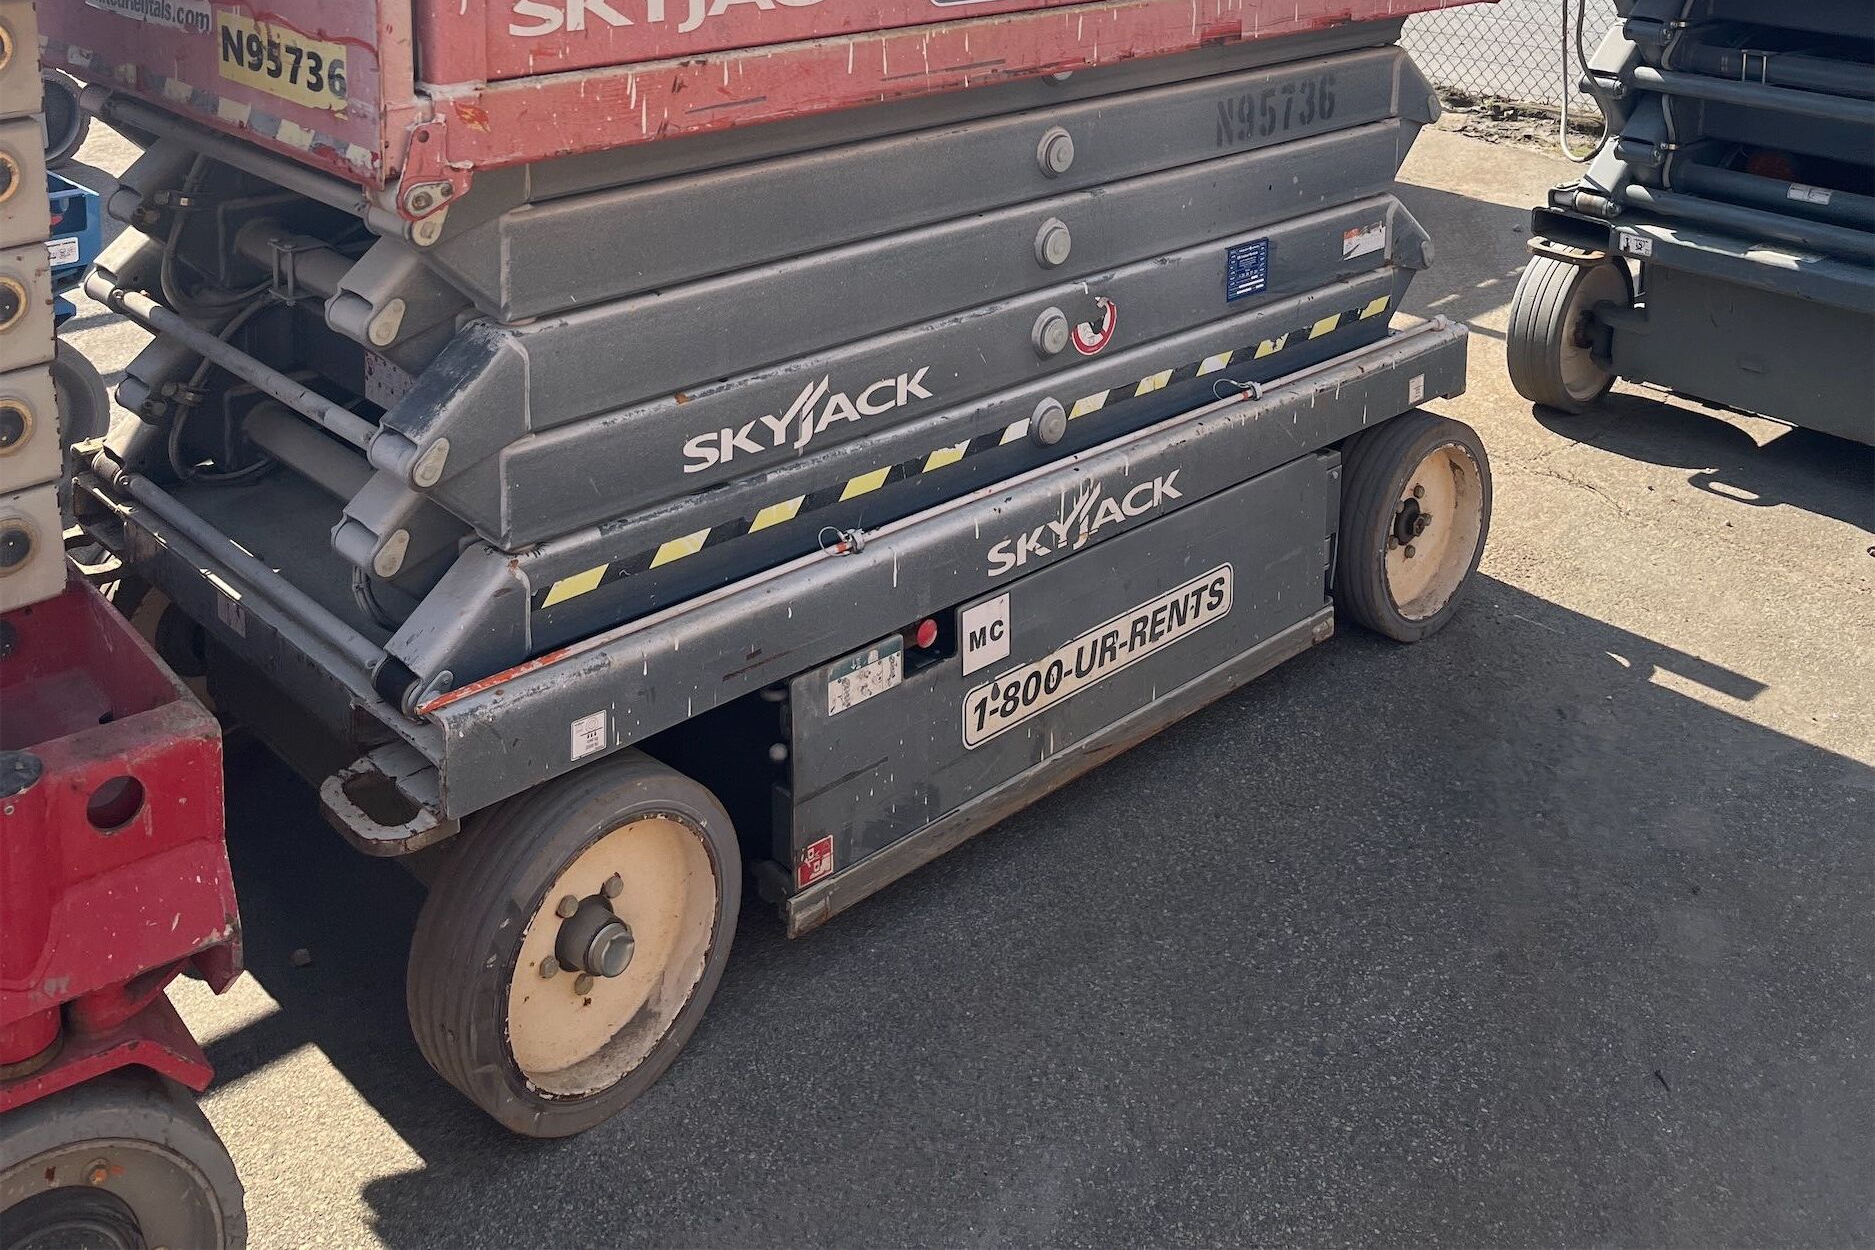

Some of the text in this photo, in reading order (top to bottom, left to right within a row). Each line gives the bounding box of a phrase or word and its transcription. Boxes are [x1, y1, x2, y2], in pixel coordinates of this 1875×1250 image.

[220, 25, 347, 99] N95736
[1216, 73, 1336, 148] N95736
[682, 365, 934, 473] SKYJACK
[987, 468, 1183, 577] SKYJACK
[969, 619, 1004, 653] MC
[973, 576, 1225, 732] 1-800-UR-RENTS
